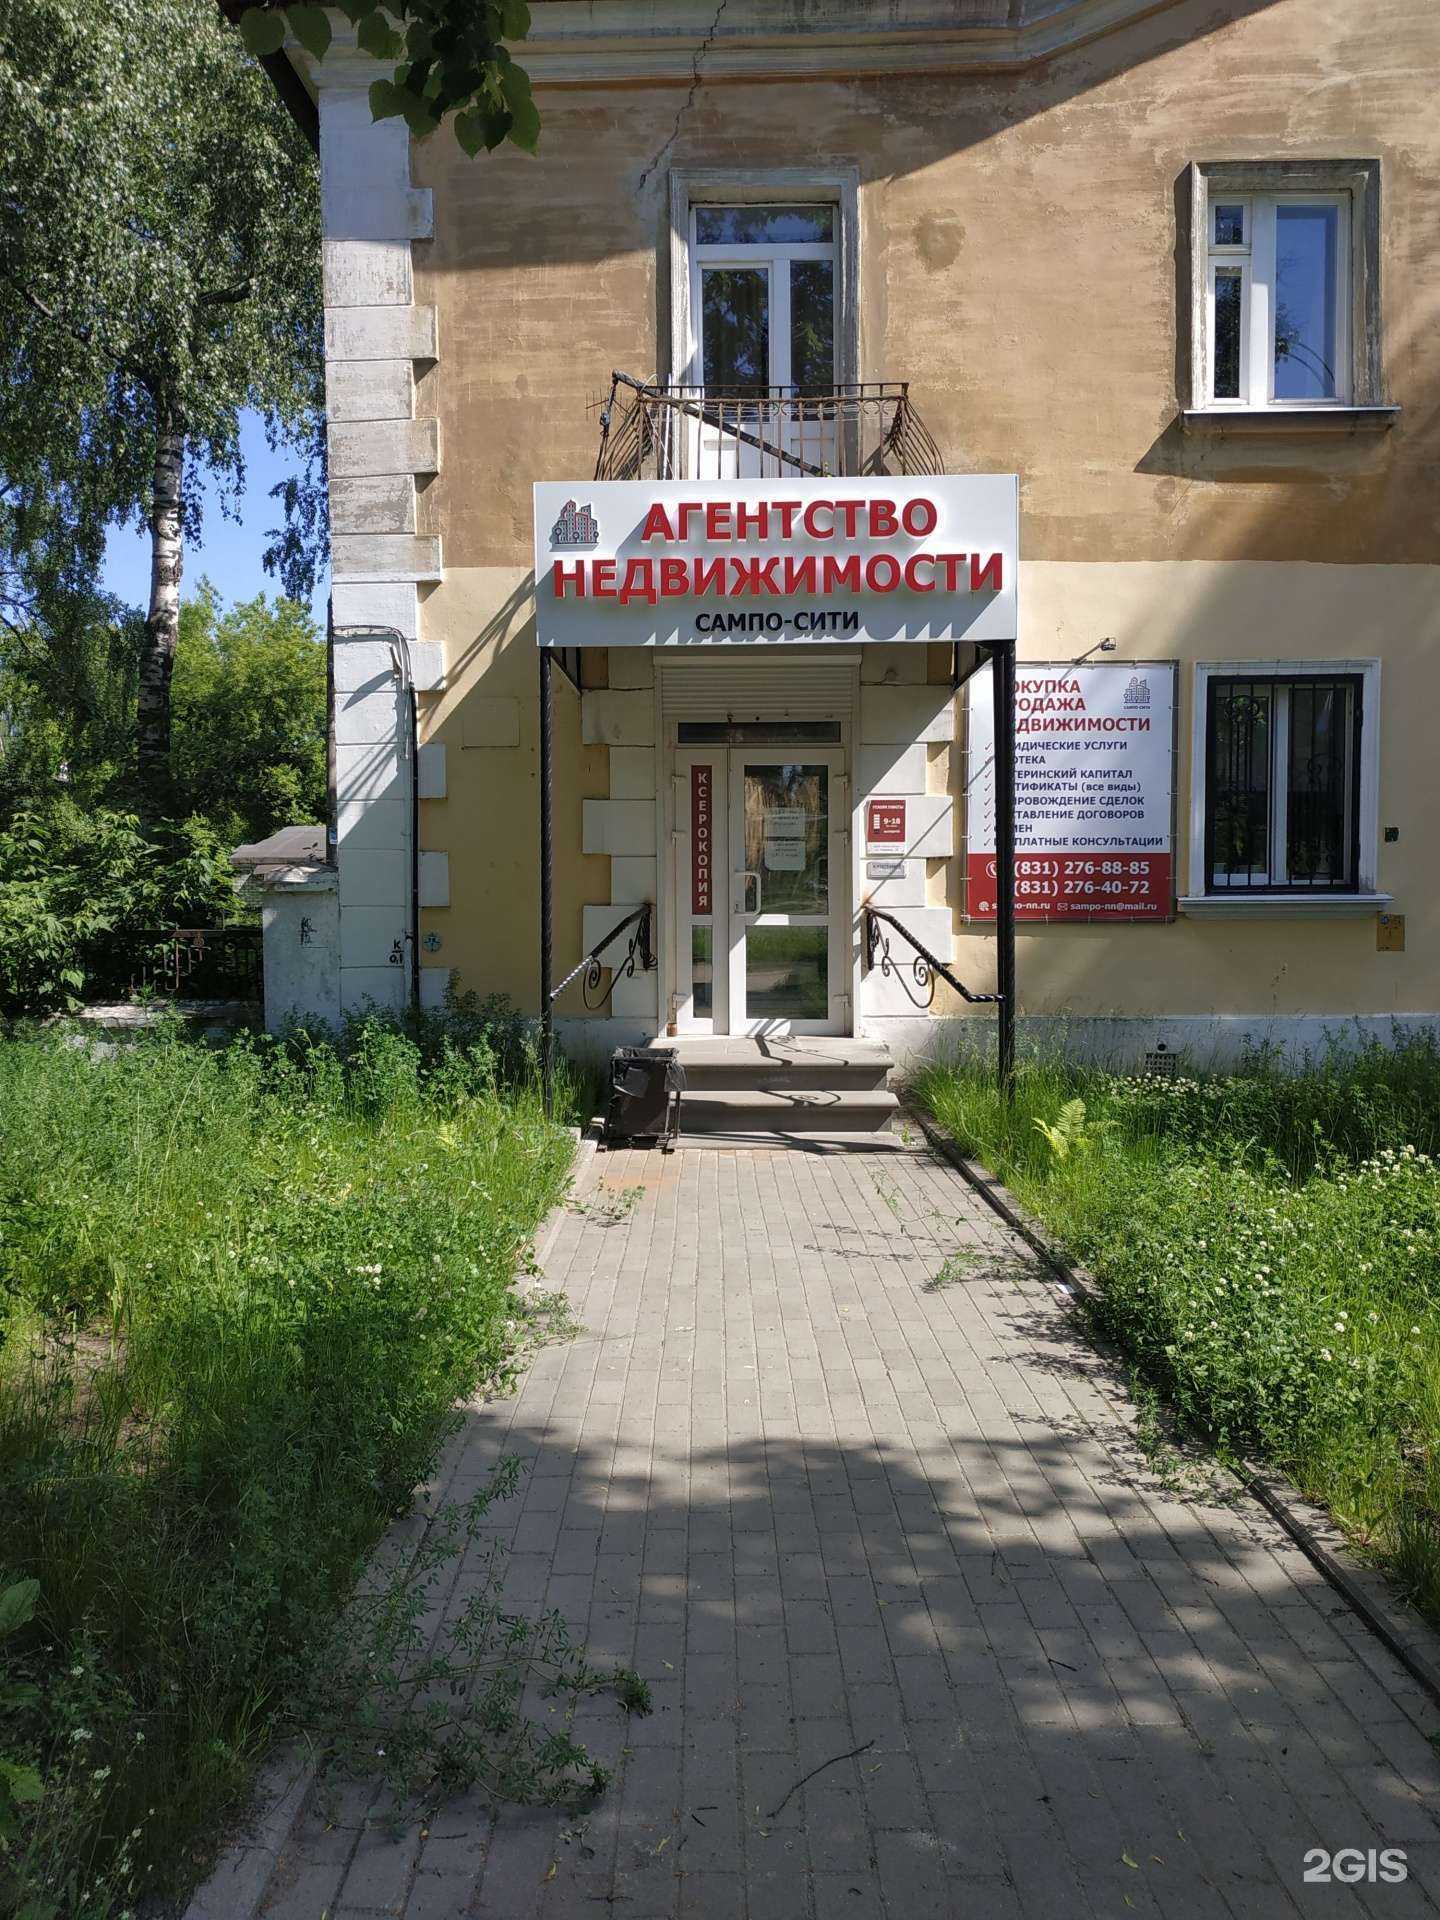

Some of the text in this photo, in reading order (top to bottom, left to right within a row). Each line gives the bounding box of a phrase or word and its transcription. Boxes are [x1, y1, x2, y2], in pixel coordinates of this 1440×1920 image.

[641, 498, 938, 543] АГЕНТСТВО
[552, 552, 1003, 605] НЕДВИЖИМОСТИ
[694, 611, 859, 632] САМПО-СИТИ
[1014, 680, 1081, 694] КУПКА
[1014, 698, 1086, 714] ОДАЖА
[1014, 717, 1151, 735] ДВИЖИМОСТИ
[1014, 741, 1128, 752] ИДИЧЕСКИЕ УСЛУГИ
[1014, 768, 1133, 779] ЕРИНСКИЙ КАПИТАЛ
[1014, 782, 1141, 793] ТИФИКАТЫ (все виды)
[1014, 796, 1145, 807] РОВОЖДЕНИЕ СДЕЛОК
[1010, 810, 1145, 820] ТАВЛЕНИЕ ДОГОВОРОВ
[697, 772, 708, 906] КСЕРОКОПИЯ
[1008, 837, 1163, 847] ПЛАТНЫЕ КОНСУЛЬТАЦИИ
[1014, 861, 1150, 878] (831) 276-88-85
[1014, 880, 1149, 897] (831) 276-40-72
[1070, 902, 1157, 911] sampo-nn@mail.ru
